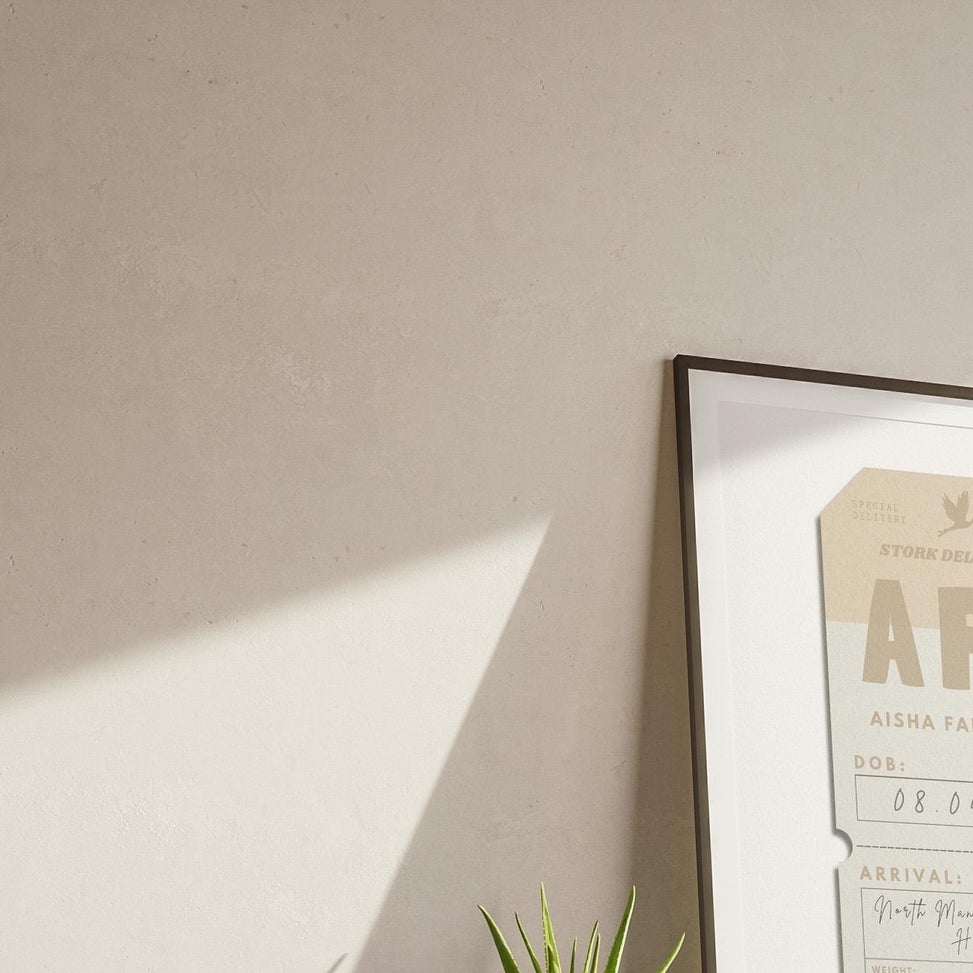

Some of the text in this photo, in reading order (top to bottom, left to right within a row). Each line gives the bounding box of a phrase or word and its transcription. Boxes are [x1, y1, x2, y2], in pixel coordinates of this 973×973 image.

[851, 500, 899, 512] SPECIAL
[852, 511, 907, 525] DELIVERY
[879, 543, 940, 561] STORK
[870, 710, 935, 730] AISHA
[854, 754, 906, 772] DOB:
[859, 865, 962, 885] ARRIVAL:
[874, 895, 927, 926] North
